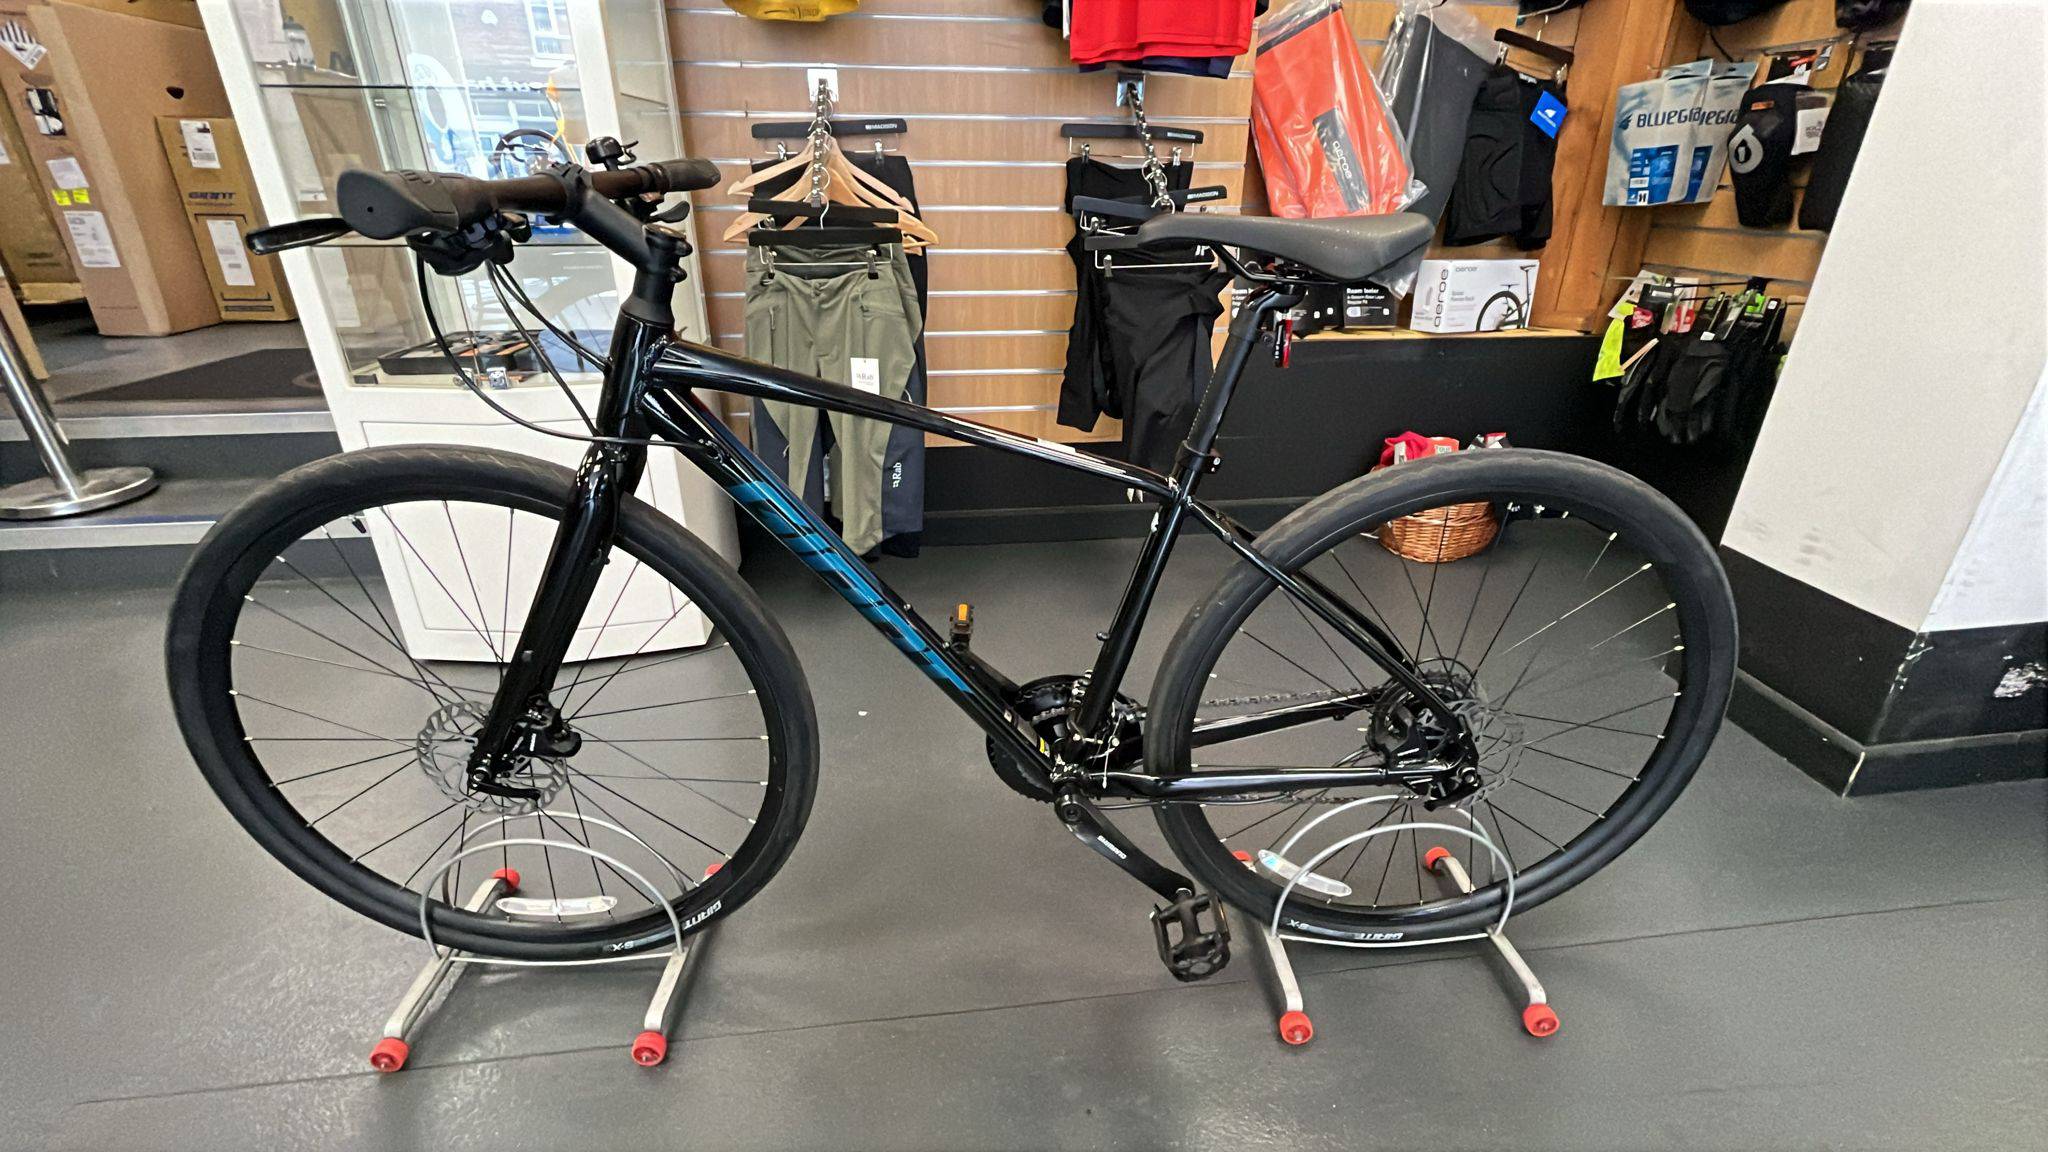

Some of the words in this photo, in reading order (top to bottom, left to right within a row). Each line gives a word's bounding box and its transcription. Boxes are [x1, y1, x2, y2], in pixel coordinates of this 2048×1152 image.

[1434, 269, 1449, 328] aeroe
[892, 462, 902, 480] Rab
[683, 900, 722, 930] GIANT
